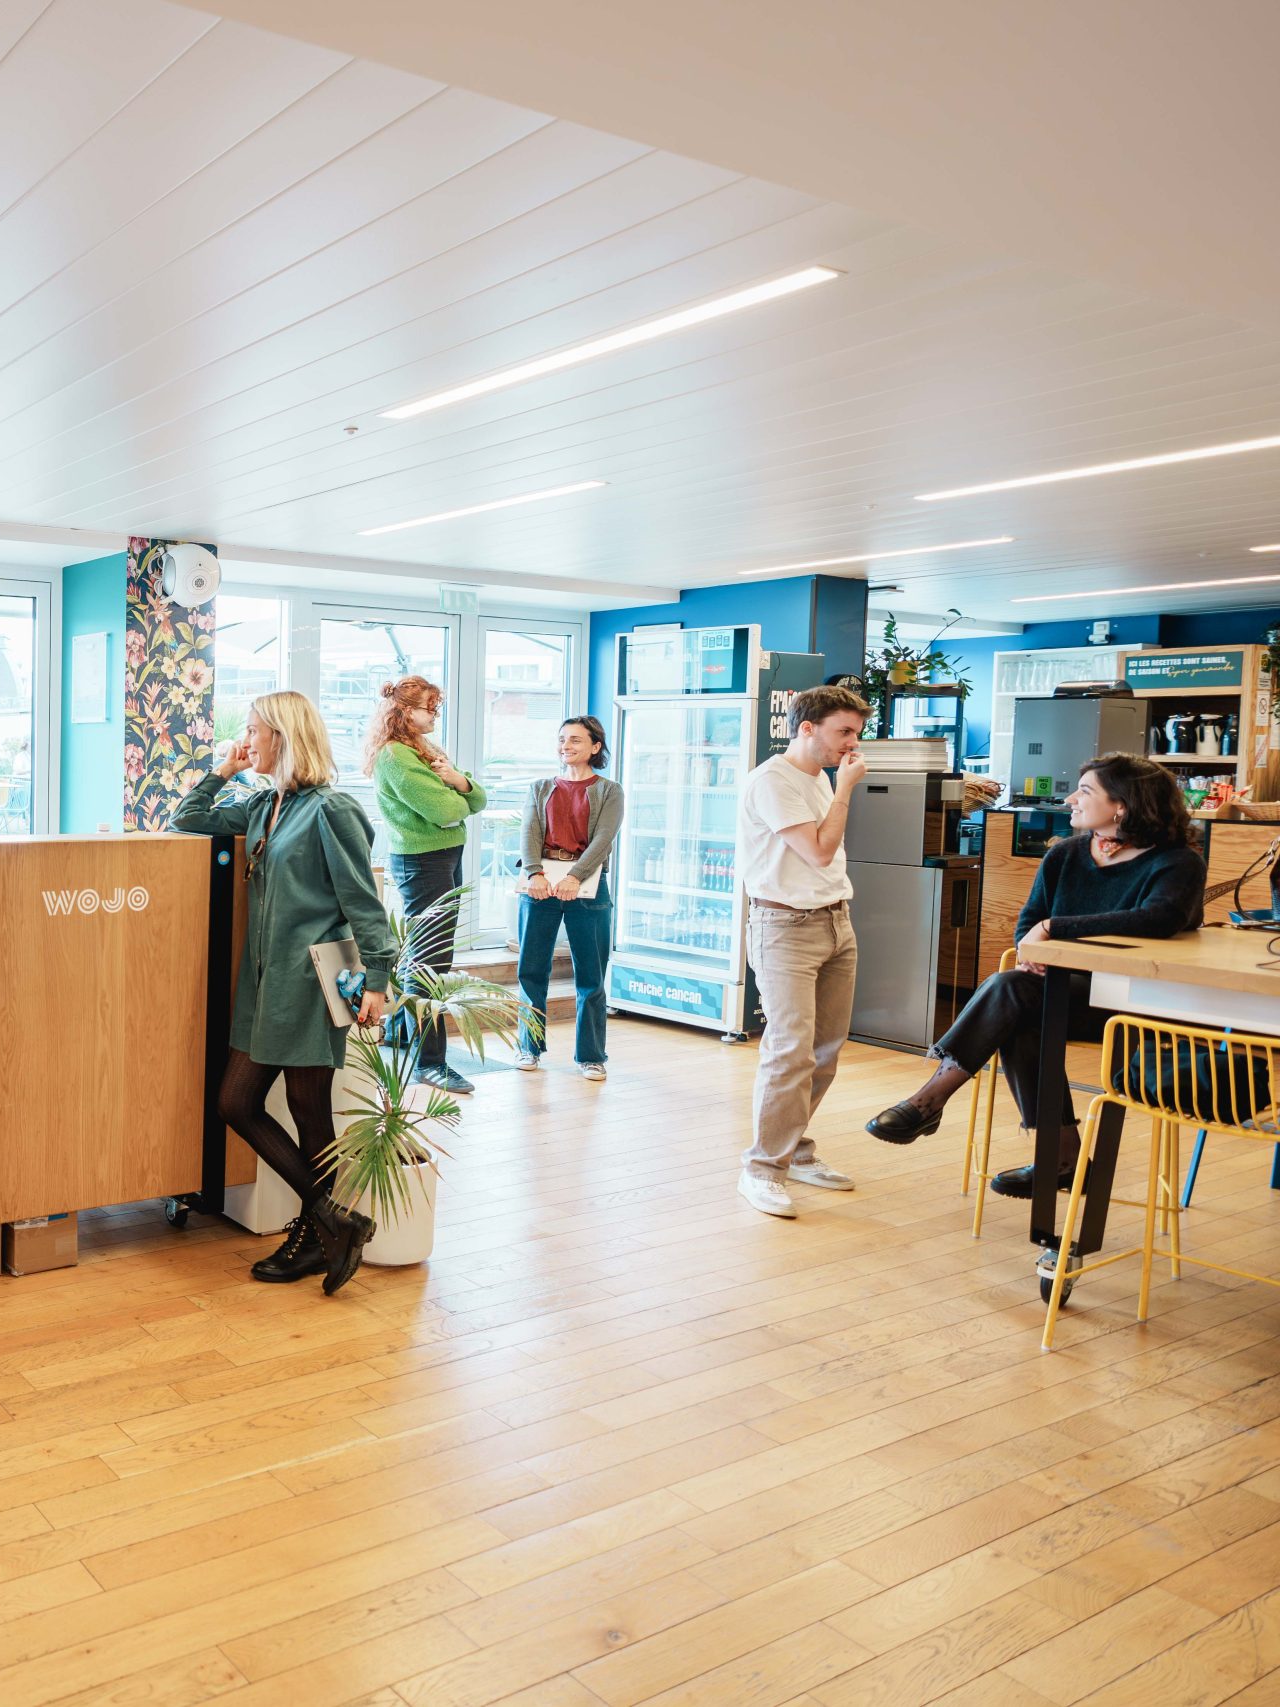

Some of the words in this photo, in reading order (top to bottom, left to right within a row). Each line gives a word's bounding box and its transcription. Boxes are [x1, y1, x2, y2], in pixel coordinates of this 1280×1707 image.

[1151, 658, 1182, 666] RECETTES
[1128, 668, 1137, 676] DE
[41, 886, 150, 917] WOJO
